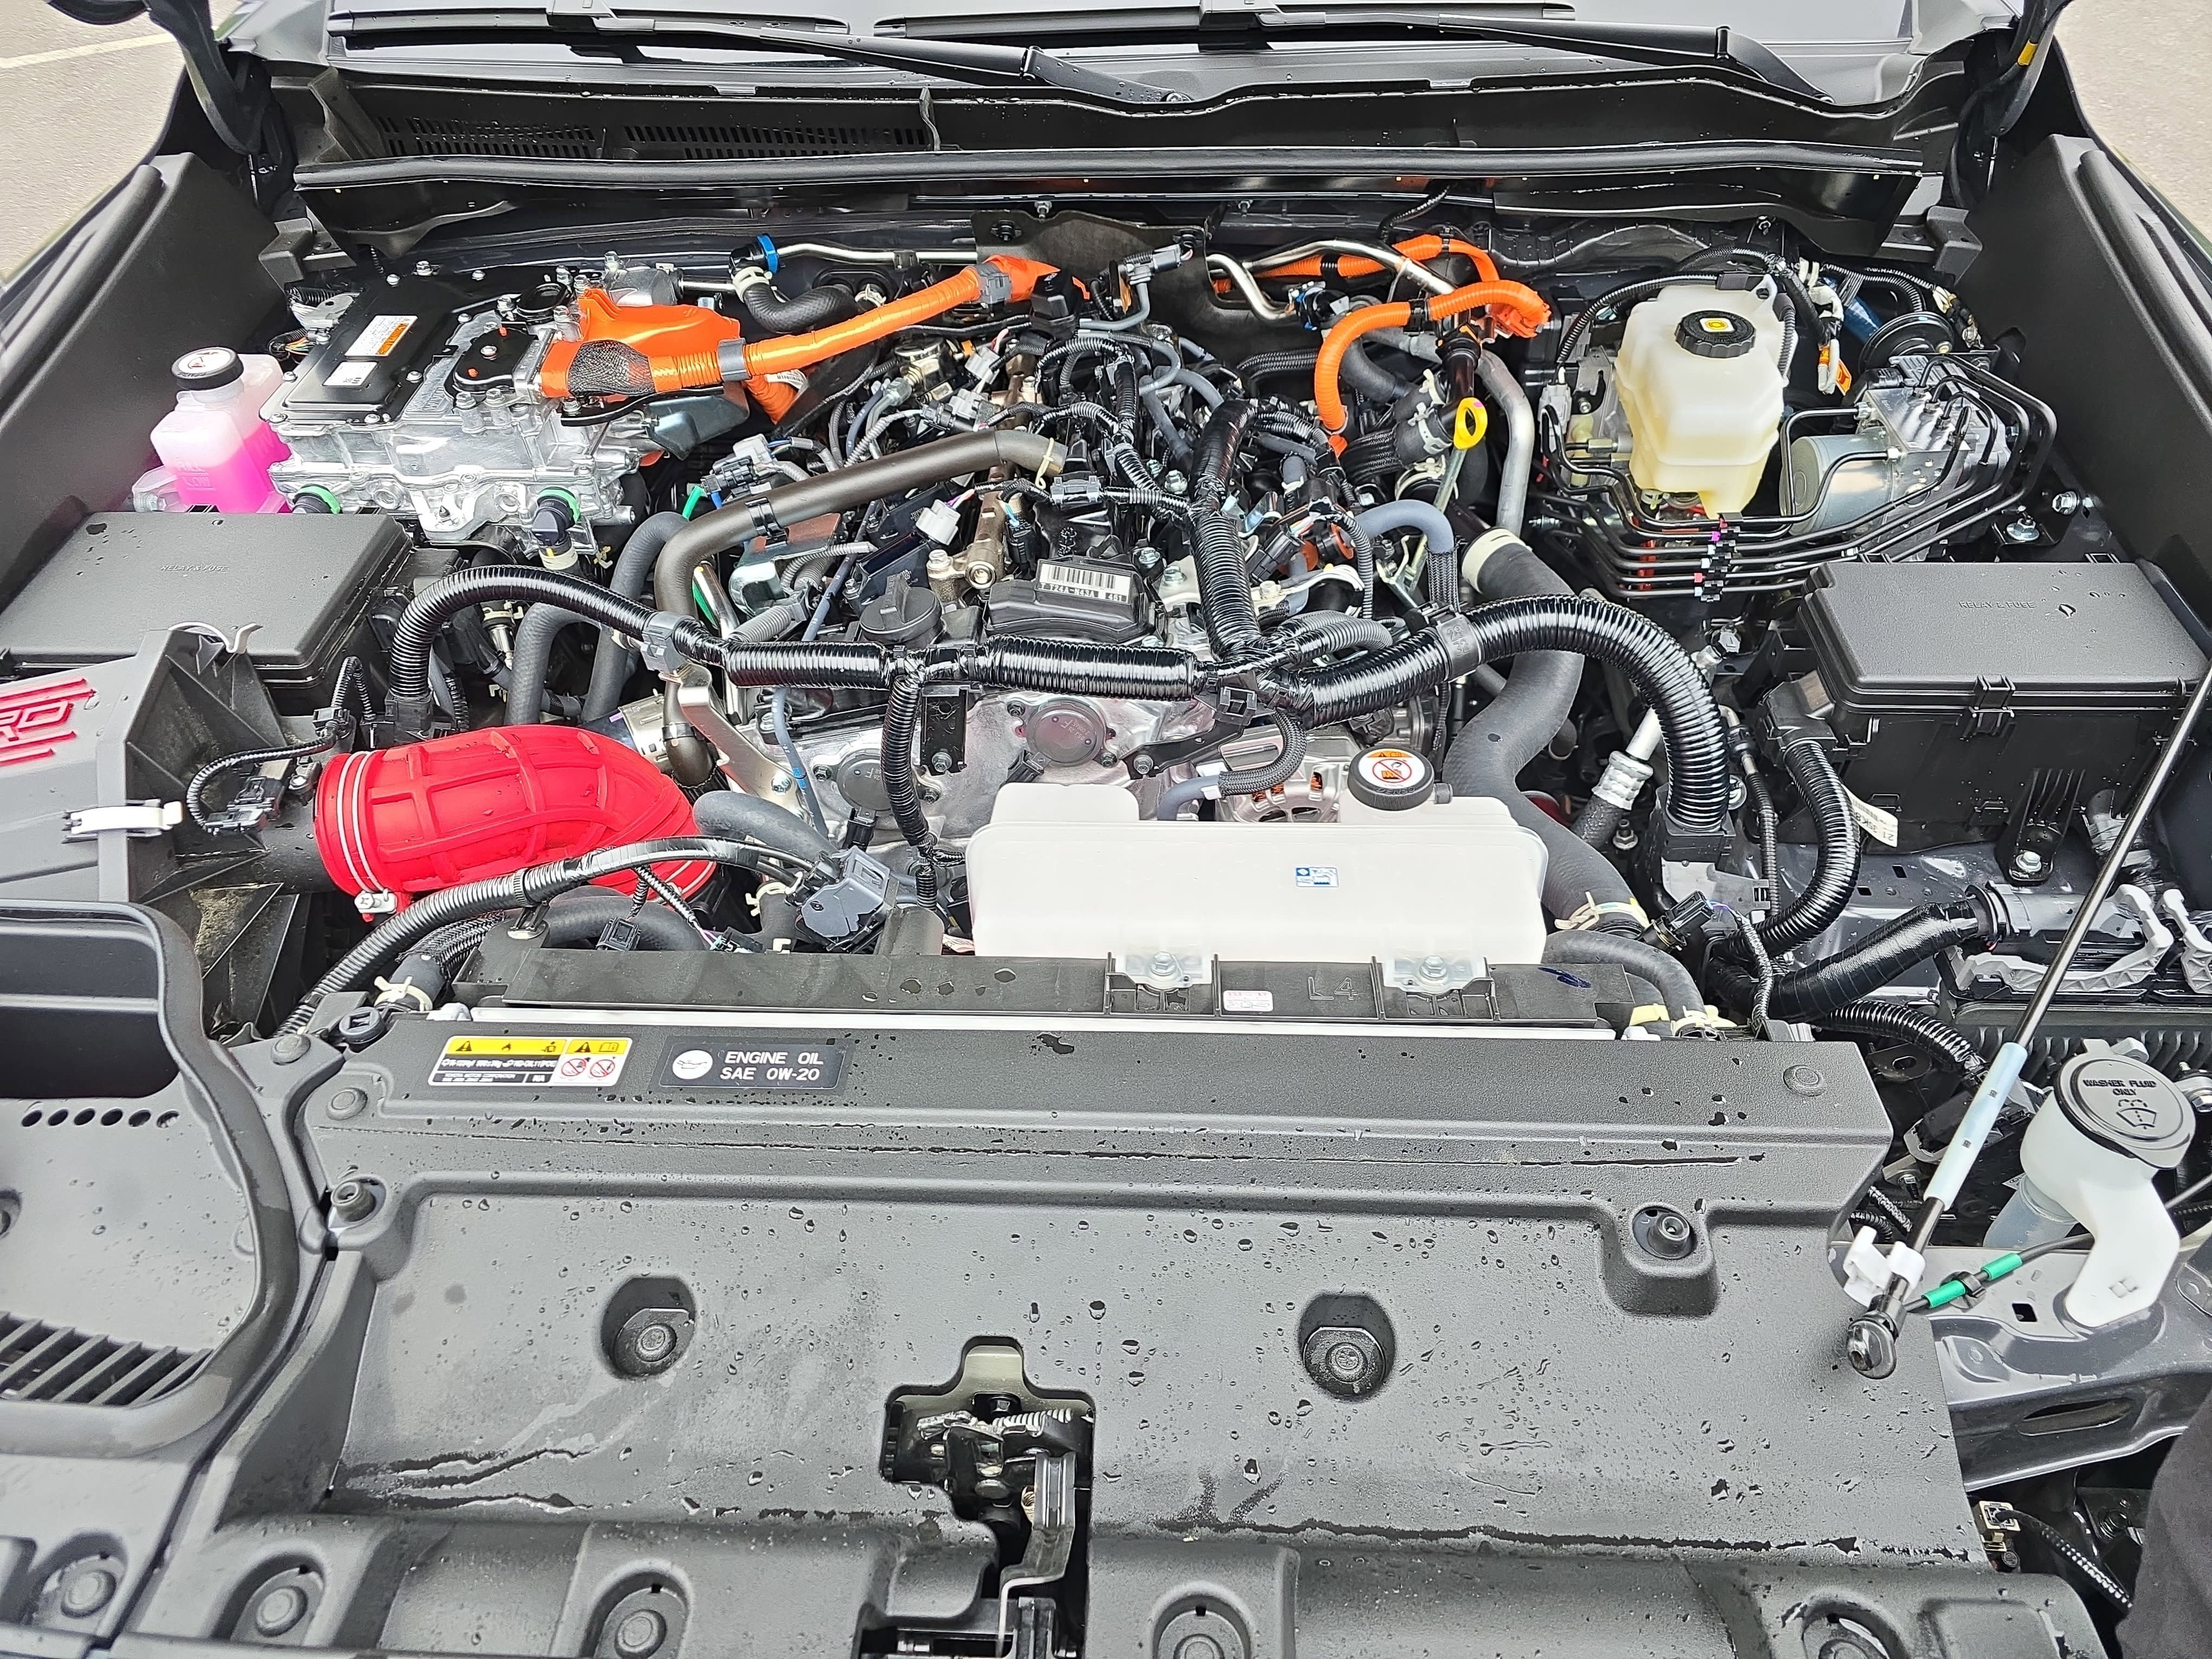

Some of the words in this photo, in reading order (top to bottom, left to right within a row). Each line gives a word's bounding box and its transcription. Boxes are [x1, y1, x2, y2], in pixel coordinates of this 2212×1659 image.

[1376, 787, 1416, 795] DENSO
[724, 1051, 788, 1064] ENGINE
[798, 1052, 824, 1065] OIL
[720, 1067, 757, 1080] SAE
[766, 1068, 820, 1081] 0W-20
